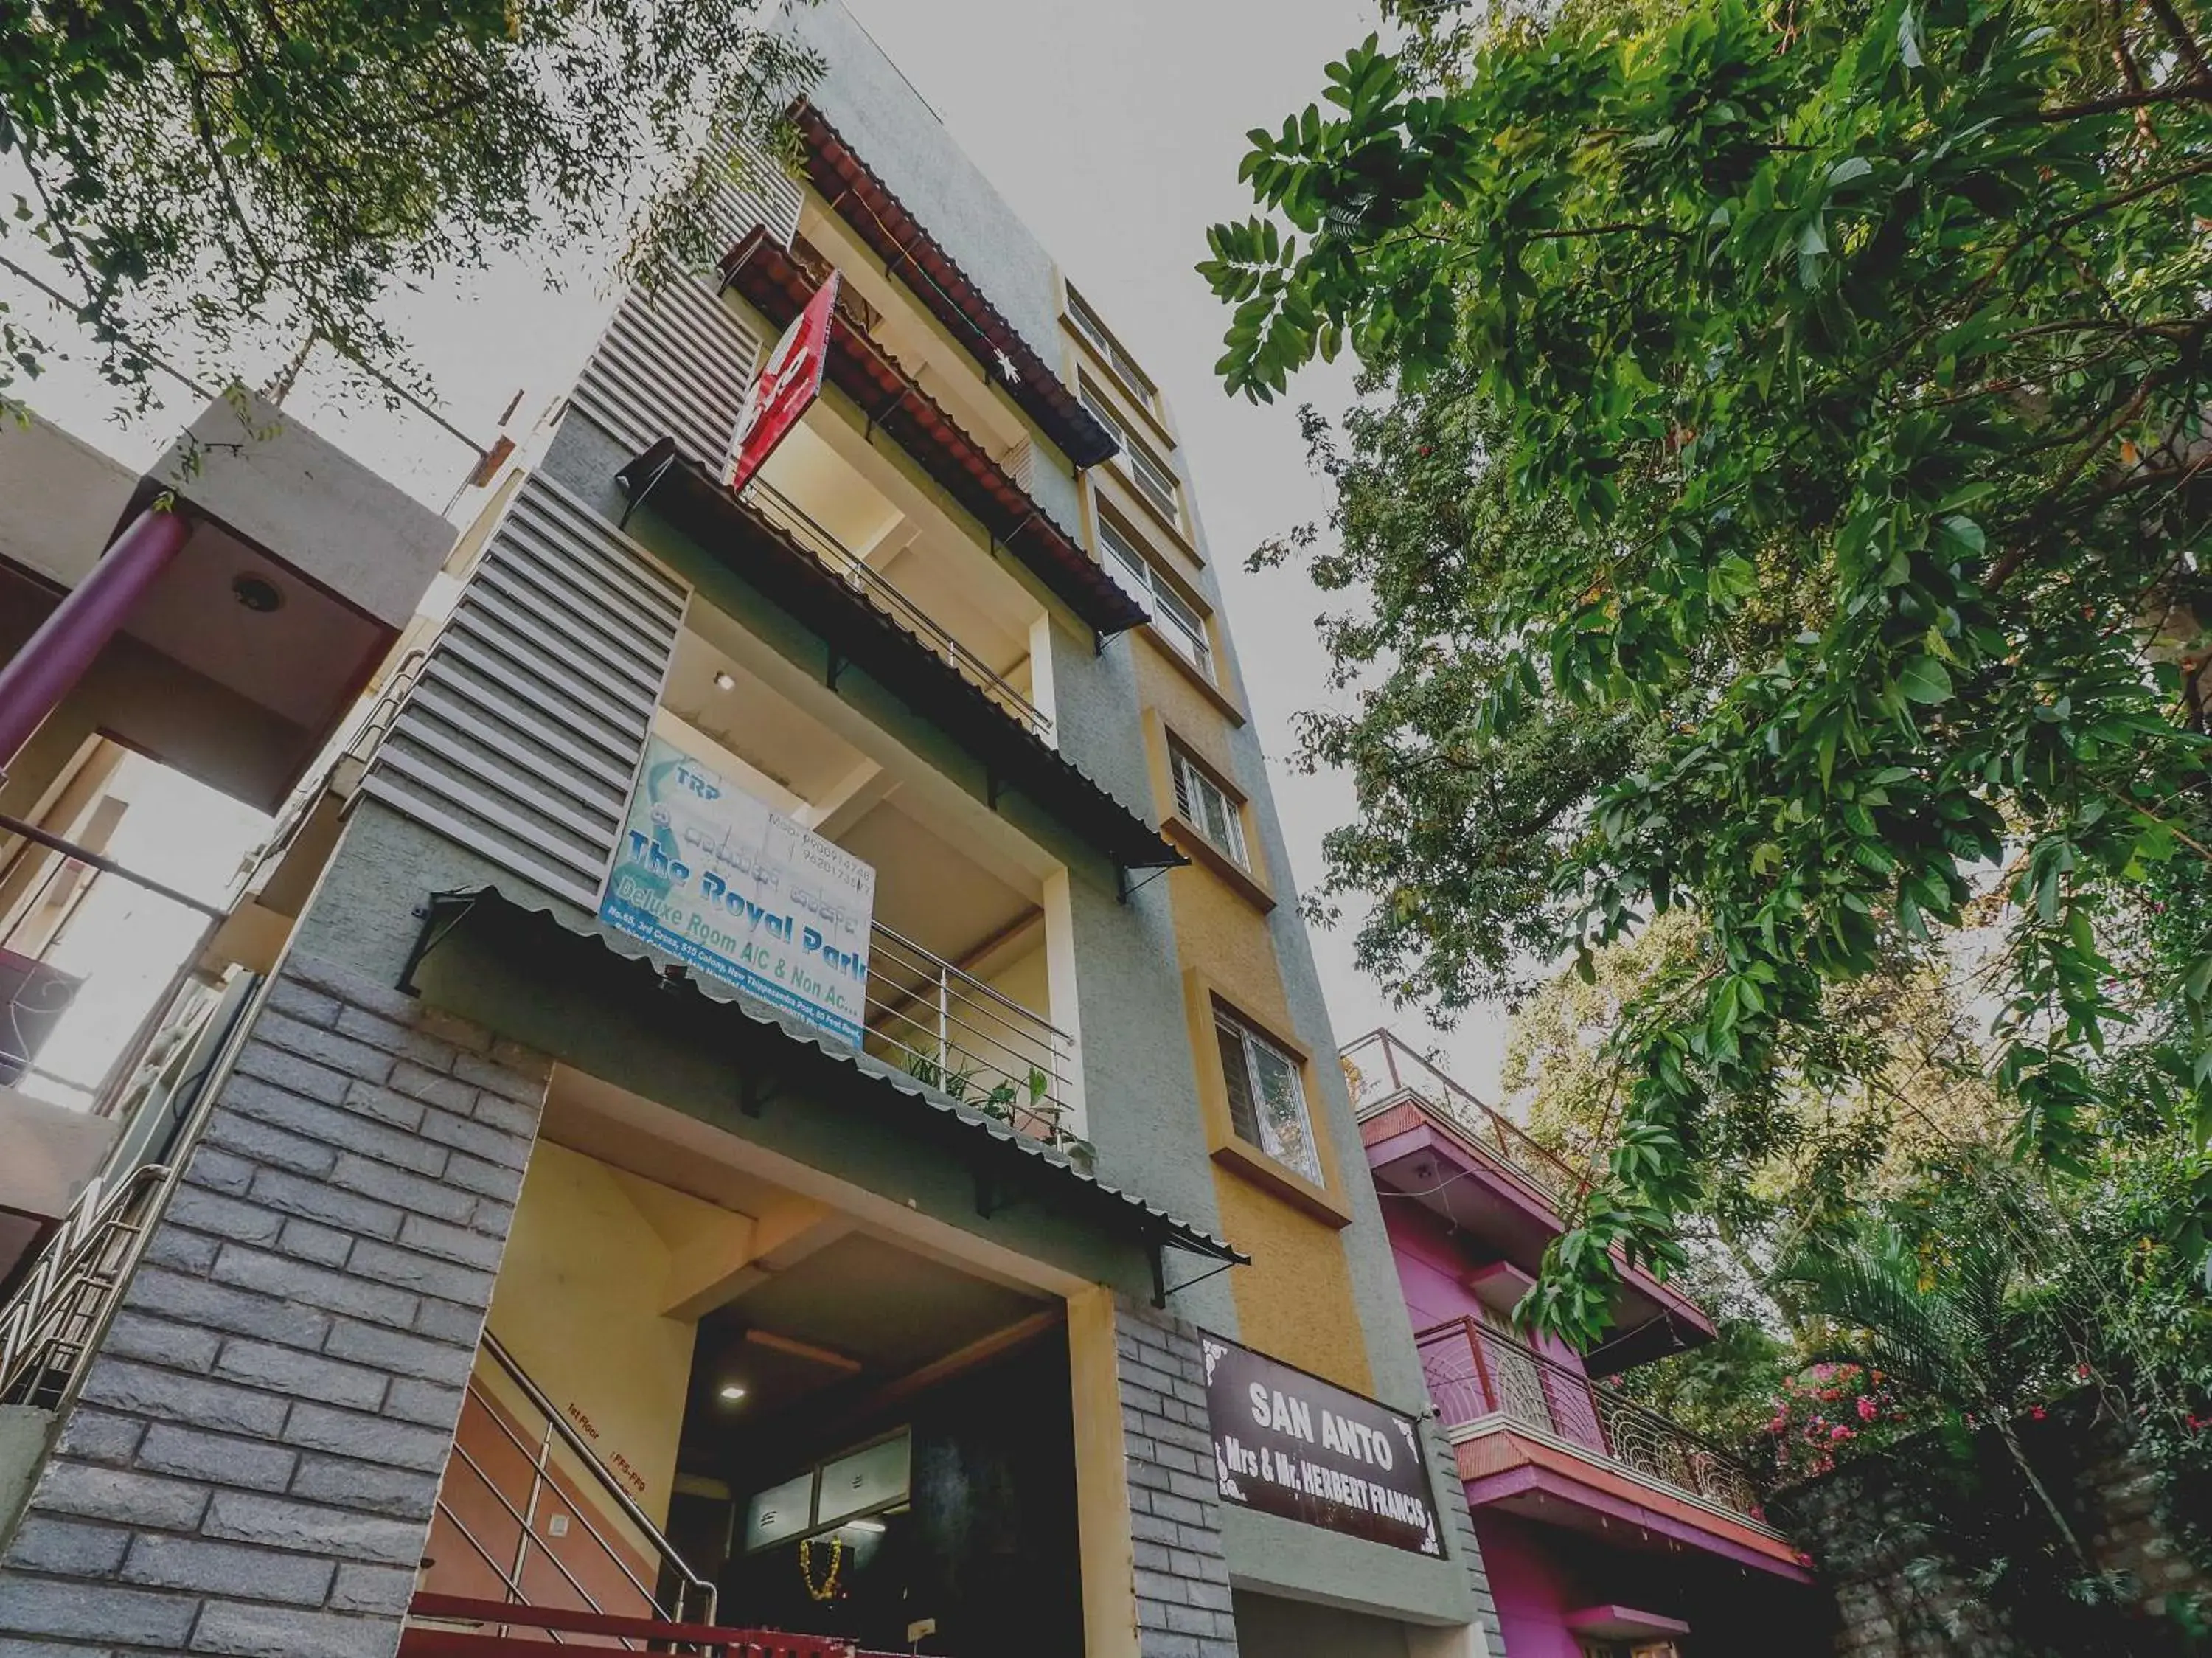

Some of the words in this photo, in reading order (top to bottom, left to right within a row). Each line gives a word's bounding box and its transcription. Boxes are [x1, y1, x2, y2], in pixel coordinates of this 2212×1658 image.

[676, 766, 721, 802] TRP
[618, 877, 683, 926] Deluxe
[687, 912, 736, 954] Room
[741, 941, 769, 971] A/C
[775, 959, 786, 979] &
[791, 966, 821, 997] Non
[627, 830, 689, 887] The
[700, 870, 794, 945] Royal
[802, 926, 868, 985] Park
[567, 1403, 580, 1420] 1st
[579, 1415, 599, 1440] Floor
[1249, 1382, 1314, 1443] SAN
[1322, 1410, 1393, 1471] ANTO
[1225, 1435, 1259, 1478] Mrs
[1261, 1447, 1275, 1482] &
[1275, 1451, 1301, 1490] Mr.
[1301, 1461, 1368, 1510] HERBERT
[1370, 1482, 1426, 1529] FRANCIS
